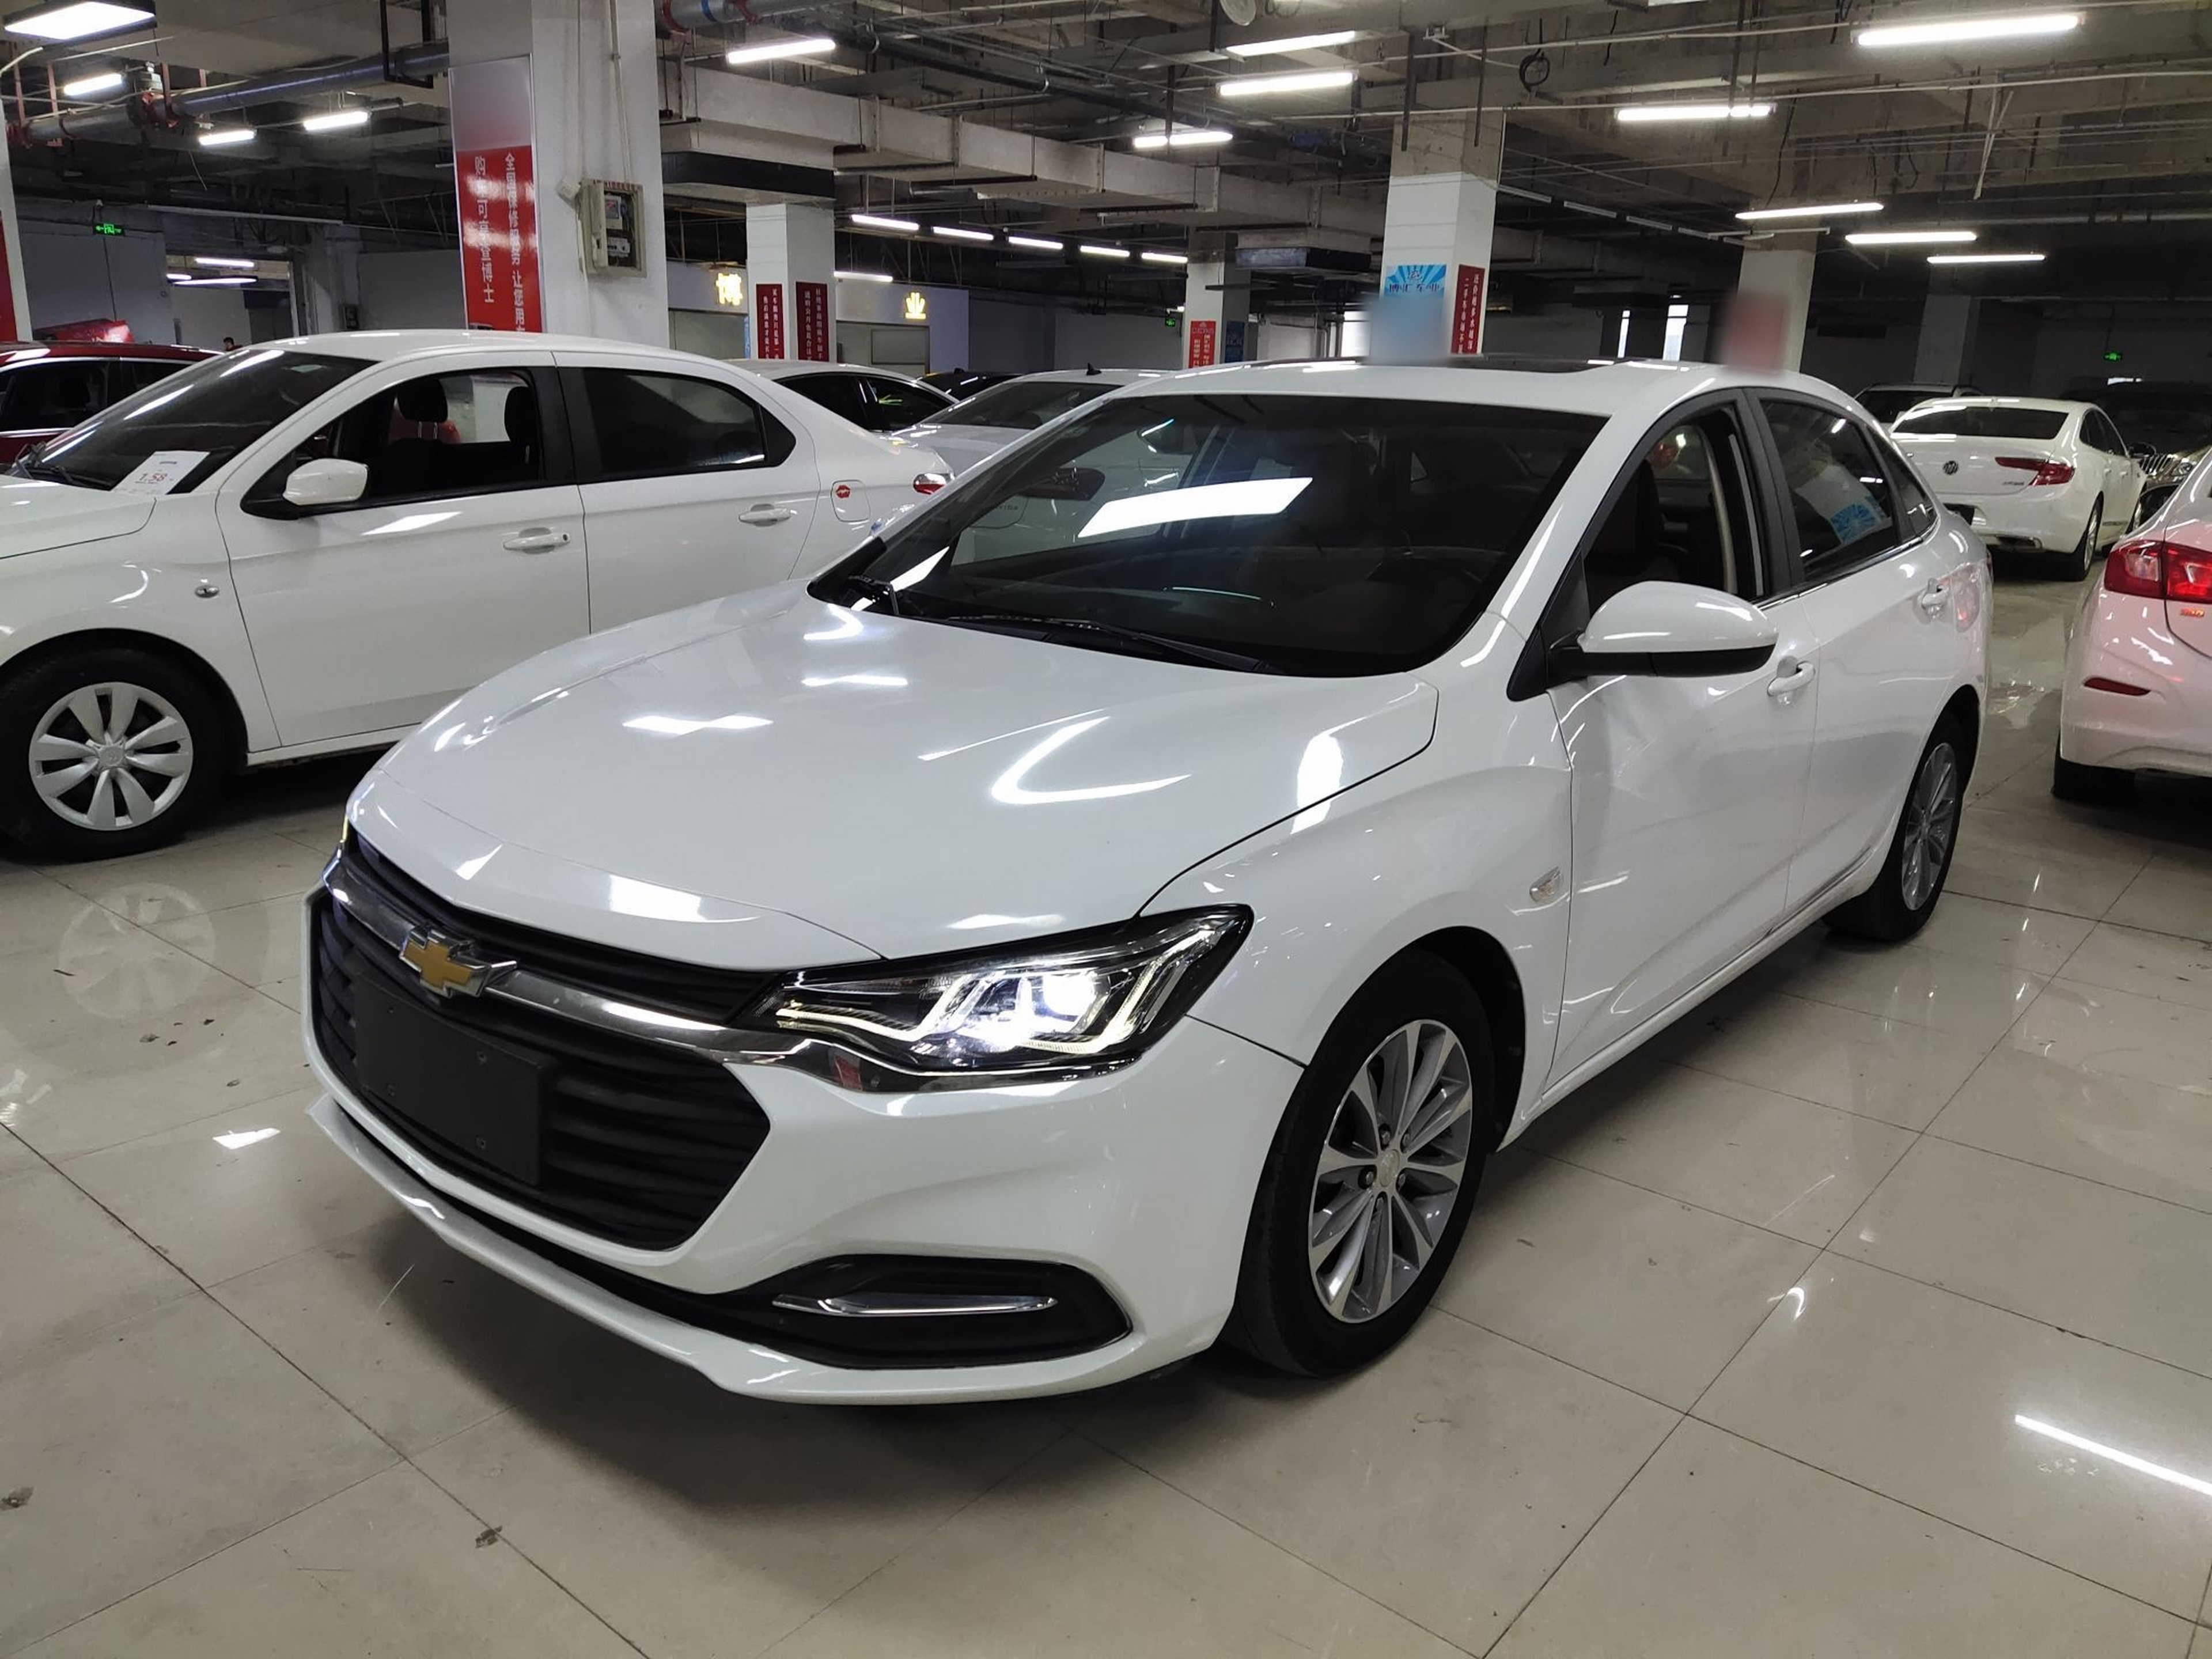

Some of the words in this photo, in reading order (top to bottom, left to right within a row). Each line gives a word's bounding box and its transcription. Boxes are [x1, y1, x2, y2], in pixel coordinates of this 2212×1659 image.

[474, 156, 494, 303] 购可享查博士
